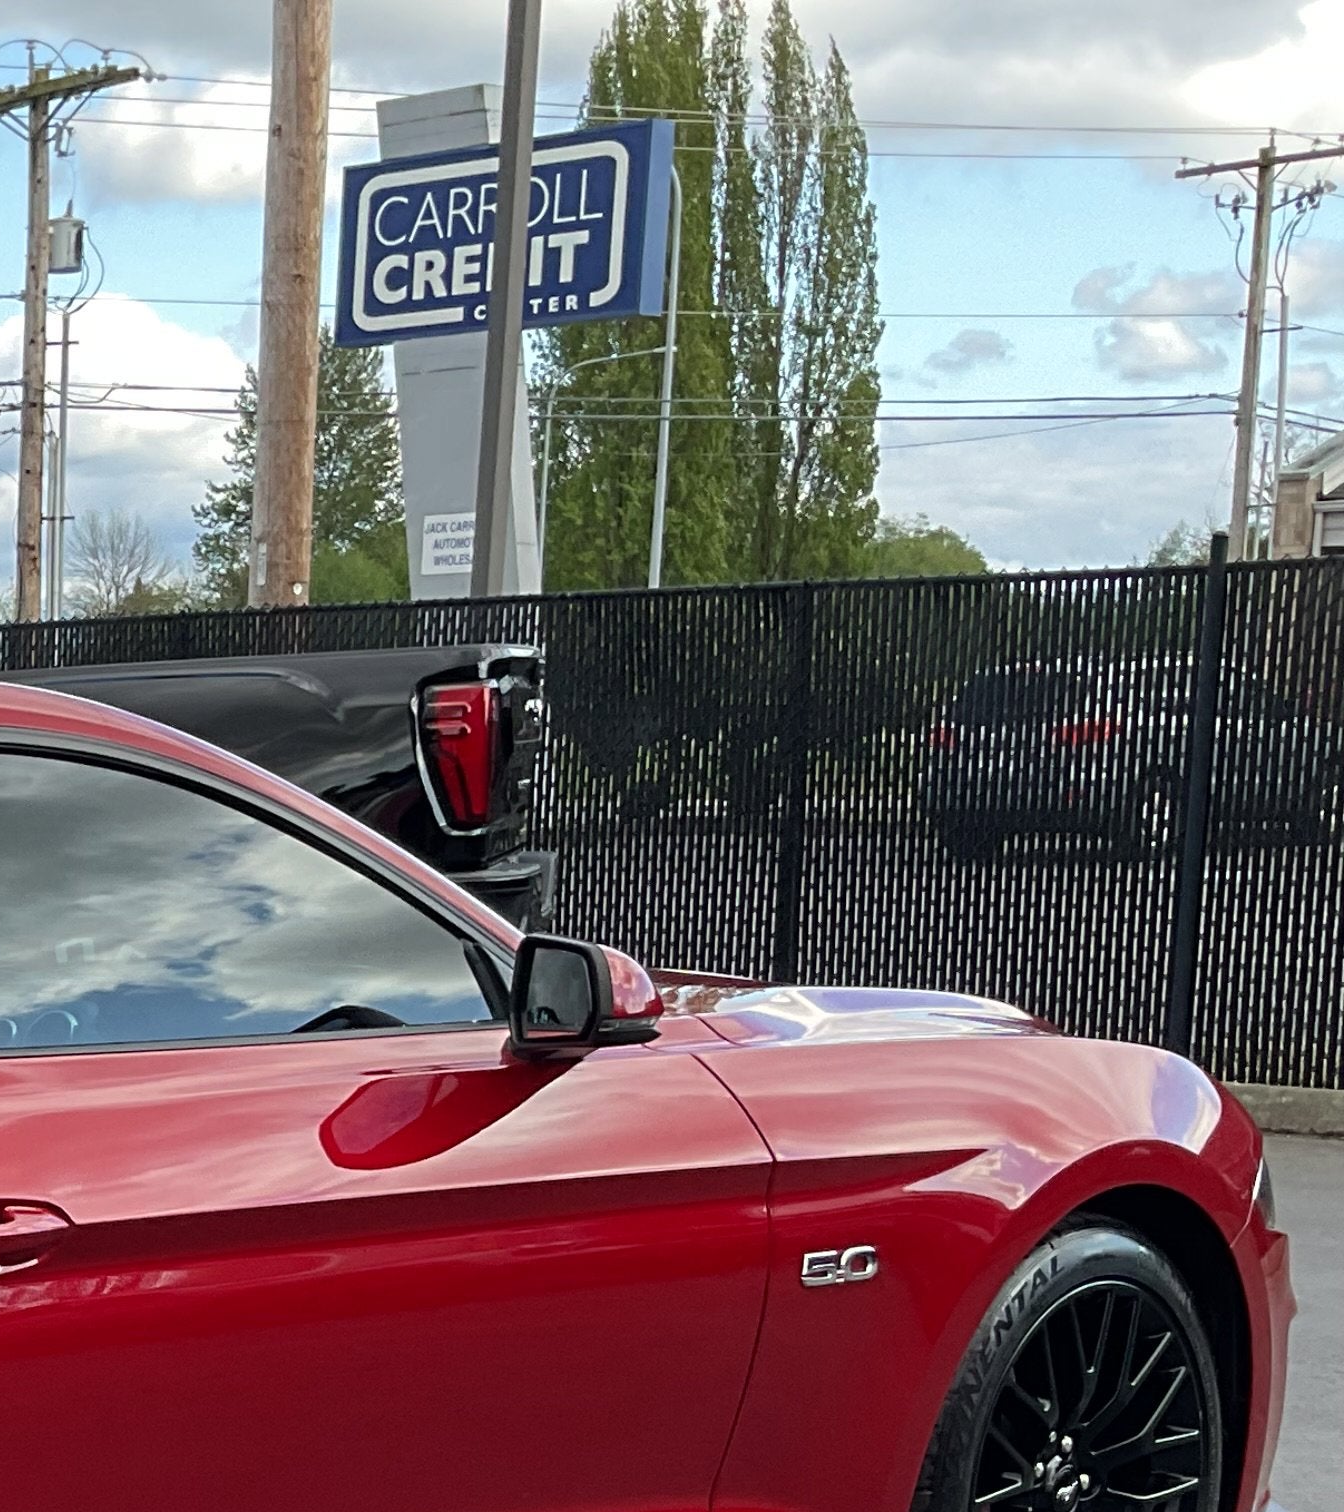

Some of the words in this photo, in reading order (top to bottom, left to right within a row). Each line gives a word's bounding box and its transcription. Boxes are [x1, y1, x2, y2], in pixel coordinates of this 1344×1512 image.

[372, 229, 590, 305] CREIT
[473, 295, 579, 322] CTER
[424, 521, 448, 534] JACK
[450, 520, 475, 533] CARR
[433, 537, 472, 550] AUTOMO
[433, 554, 472, 566] WHOLES
[800, 1245, 878, 1288] 5.0
